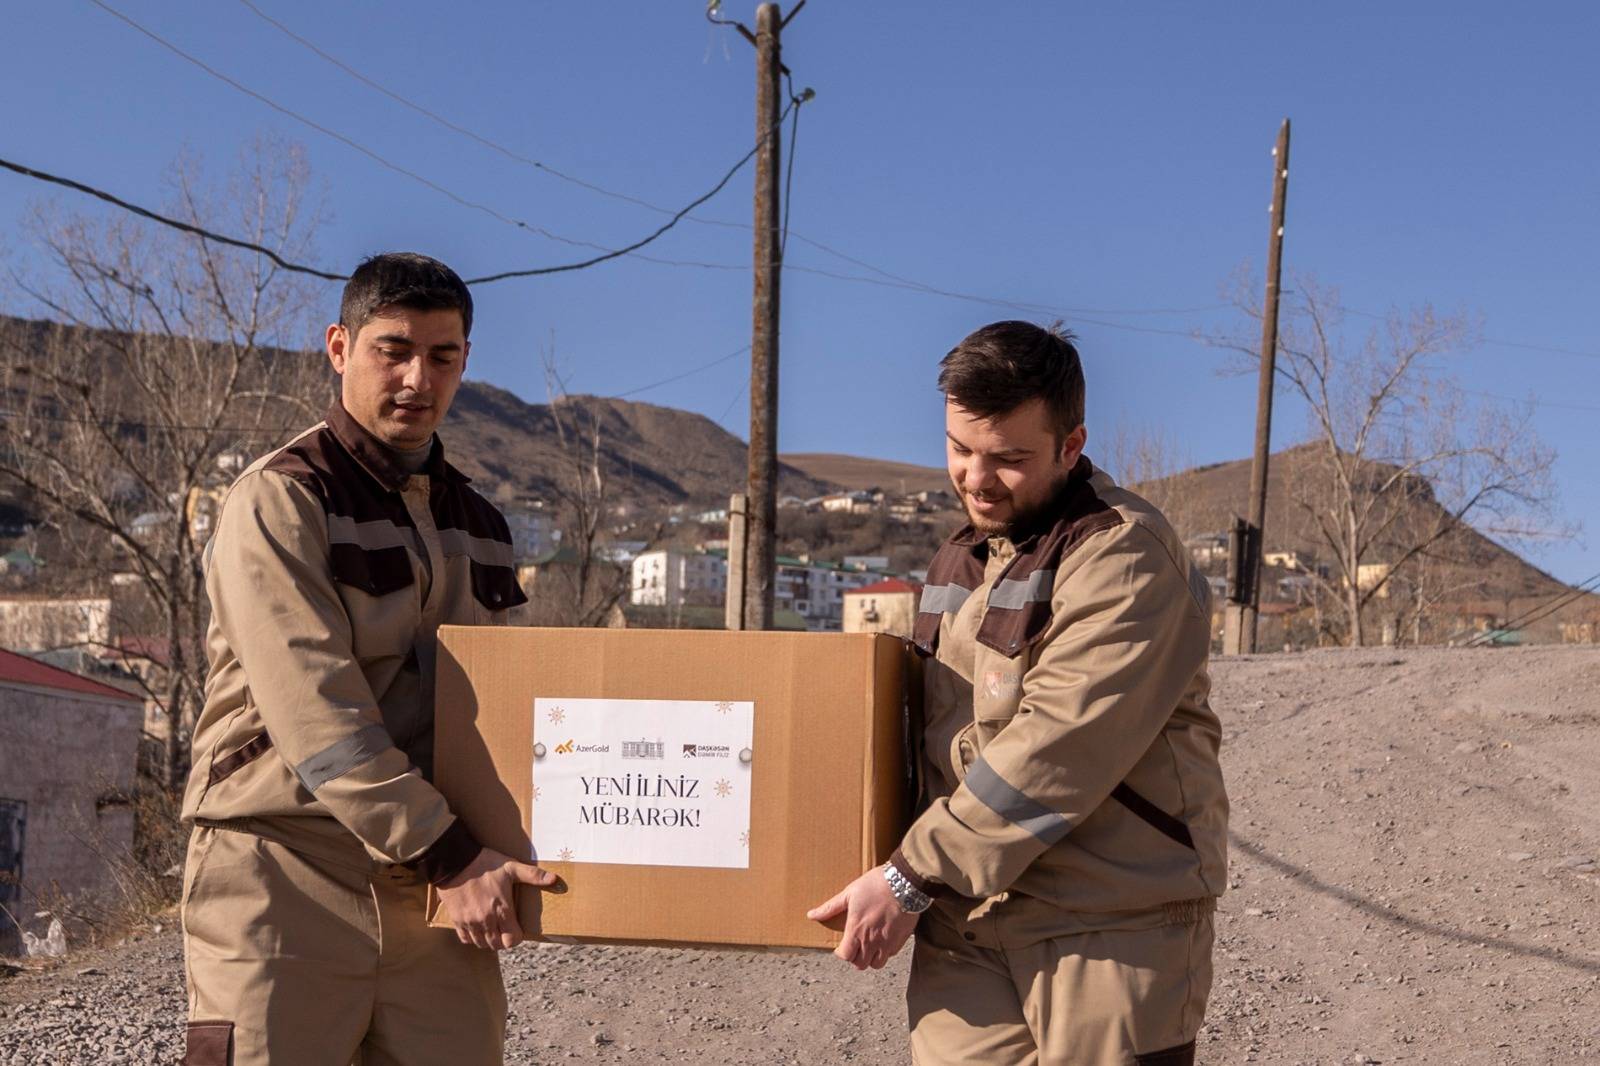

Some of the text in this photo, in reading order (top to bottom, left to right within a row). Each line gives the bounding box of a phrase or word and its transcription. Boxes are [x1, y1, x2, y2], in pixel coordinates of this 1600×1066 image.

[576, 744, 609, 753] AzerGold
[580, 773, 700, 799] YENİ İLİNİZ
[578, 802, 701, 828] MÜBARƏK!
